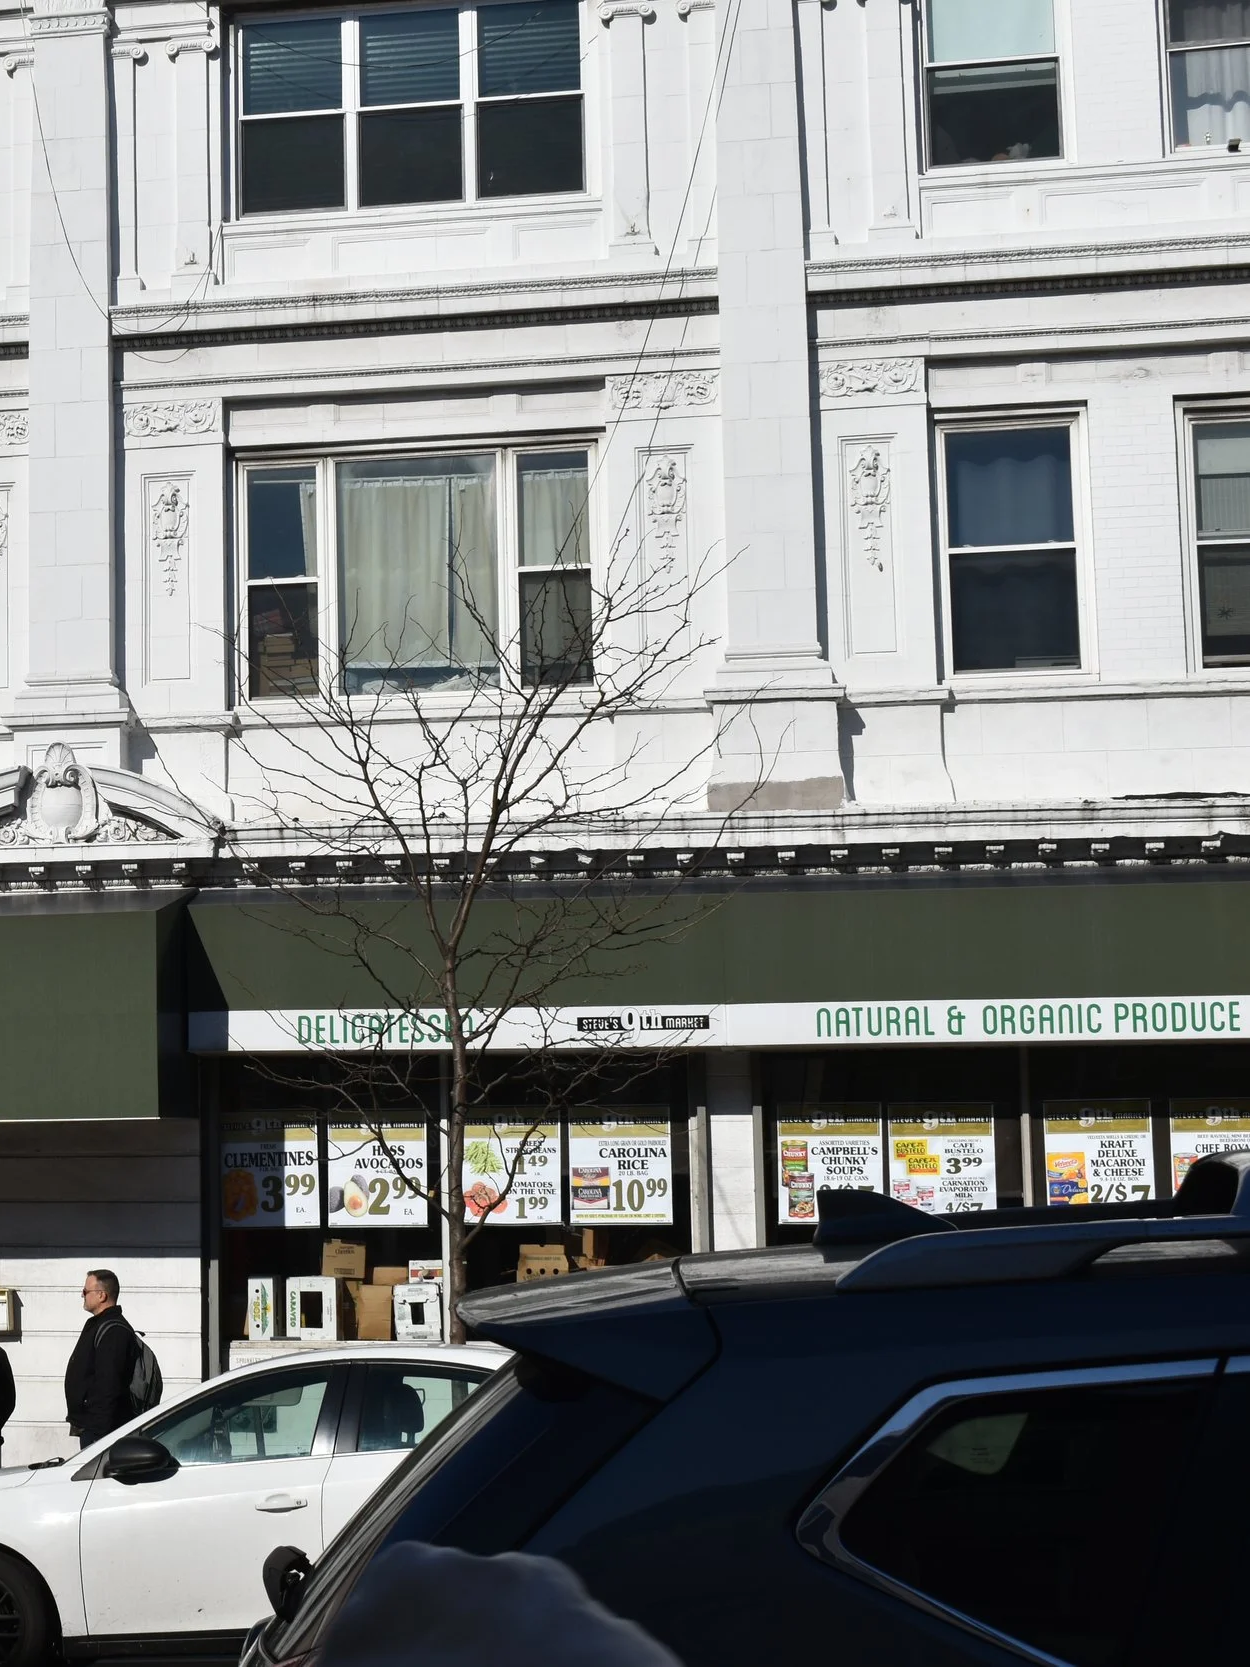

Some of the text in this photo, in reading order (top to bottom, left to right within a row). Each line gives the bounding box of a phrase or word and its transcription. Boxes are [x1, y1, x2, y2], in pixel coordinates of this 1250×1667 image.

[816, 1001, 1241, 1038] NATURAL & ORGANIC PRODUCE
[582, 1007, 704, 1043] STEVE'S 9th MARKET
[1100, 1140, 1134, 1149] KRAFT
[1195, 1143, 1220, 1154] CHEF
[372, 1145, 405, 1156] HSS
[599, 1147, 667, 1158] CAROLINA
[811, 1146, 878, 1156] CAMPBELL'S
[1097, 1149, 1138, 1158] DELUXE
[224, 1150, 314, 1169] CLEMENTINES
[617, 1159, 649, 1170] RICE
[821, 1156, 869, 1165] CHUNKY
[1090, 1158, 1146, 1168] MACARONI
[826, 1166, 864, 1175] SOUPS
[1092, 1168, 1145, 1177] & CHEESE
